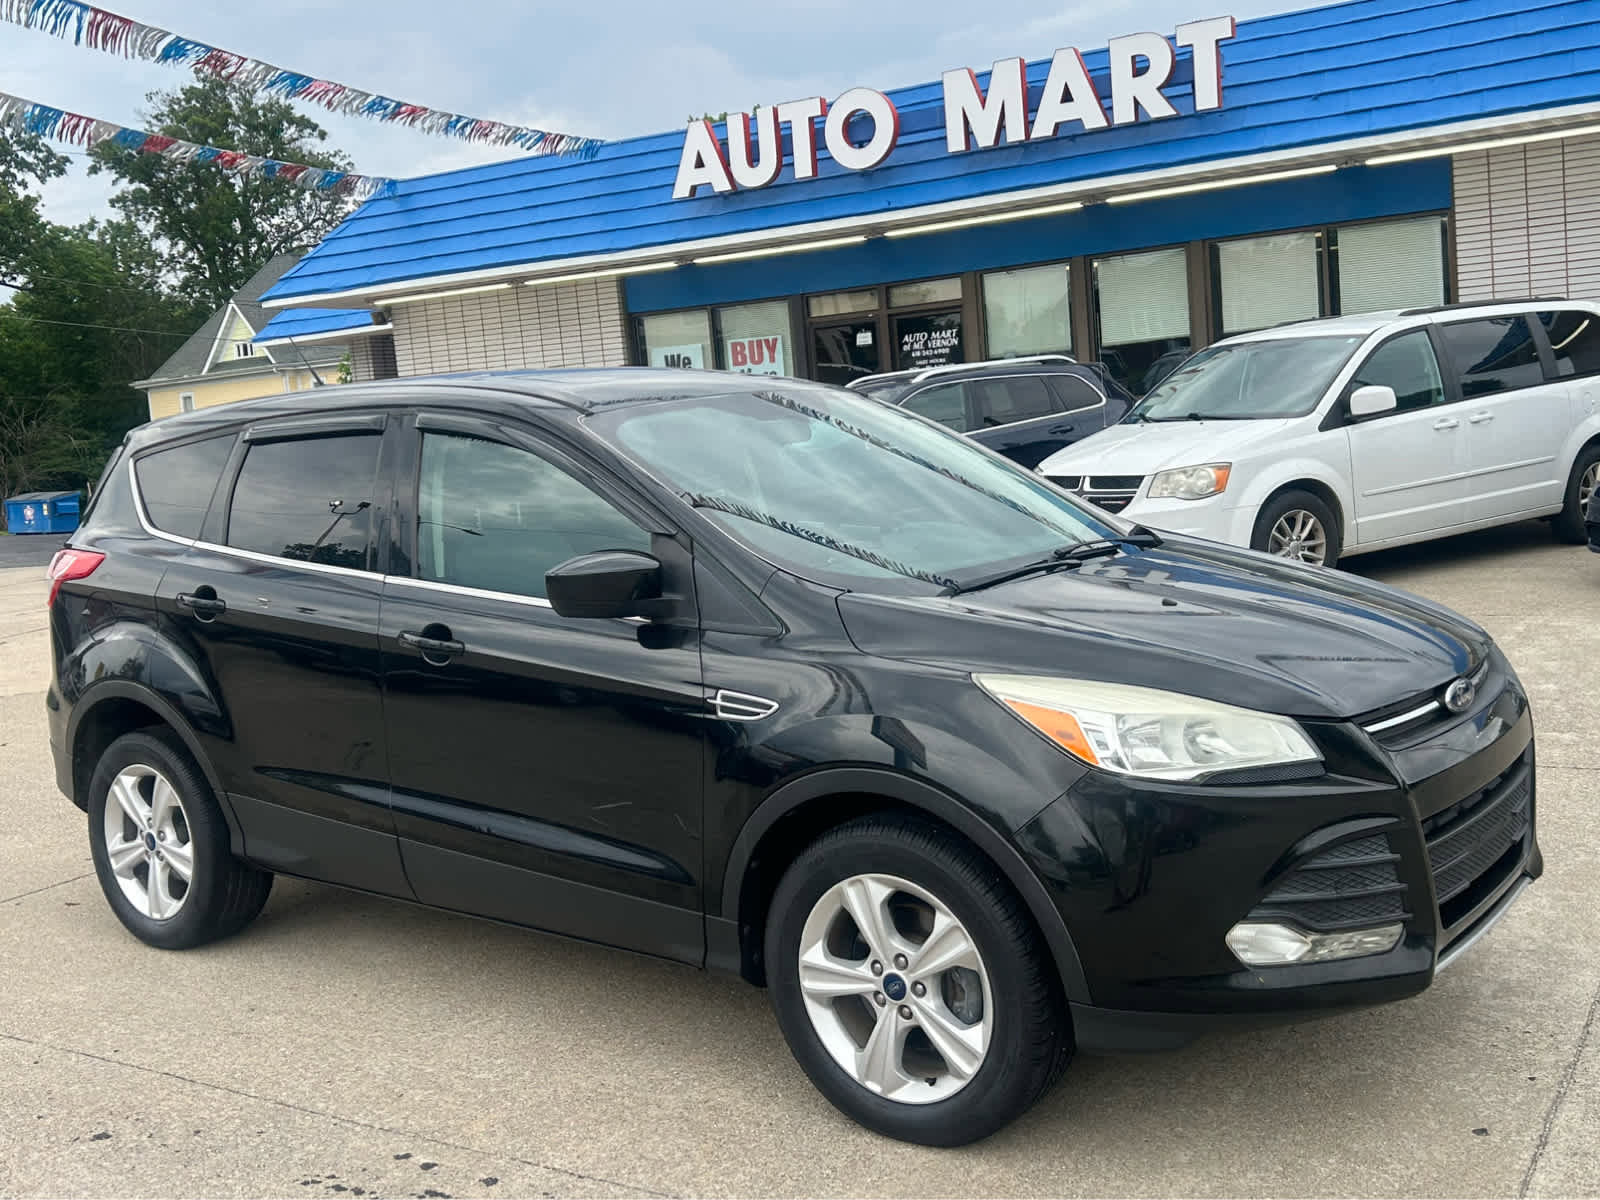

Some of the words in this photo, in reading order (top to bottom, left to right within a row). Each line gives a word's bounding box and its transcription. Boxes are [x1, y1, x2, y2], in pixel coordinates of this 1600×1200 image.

[672, 87, 898, 199] AUTO
[941, 16, 1236, 154] MART
[902, 332, 928, 343] AUTO
[930, 328, 958, 339] MART
[928, 338, 958, 347] VERNON
[731, 337, 778, 367] BUY
[664, 353, 692, 368] We
